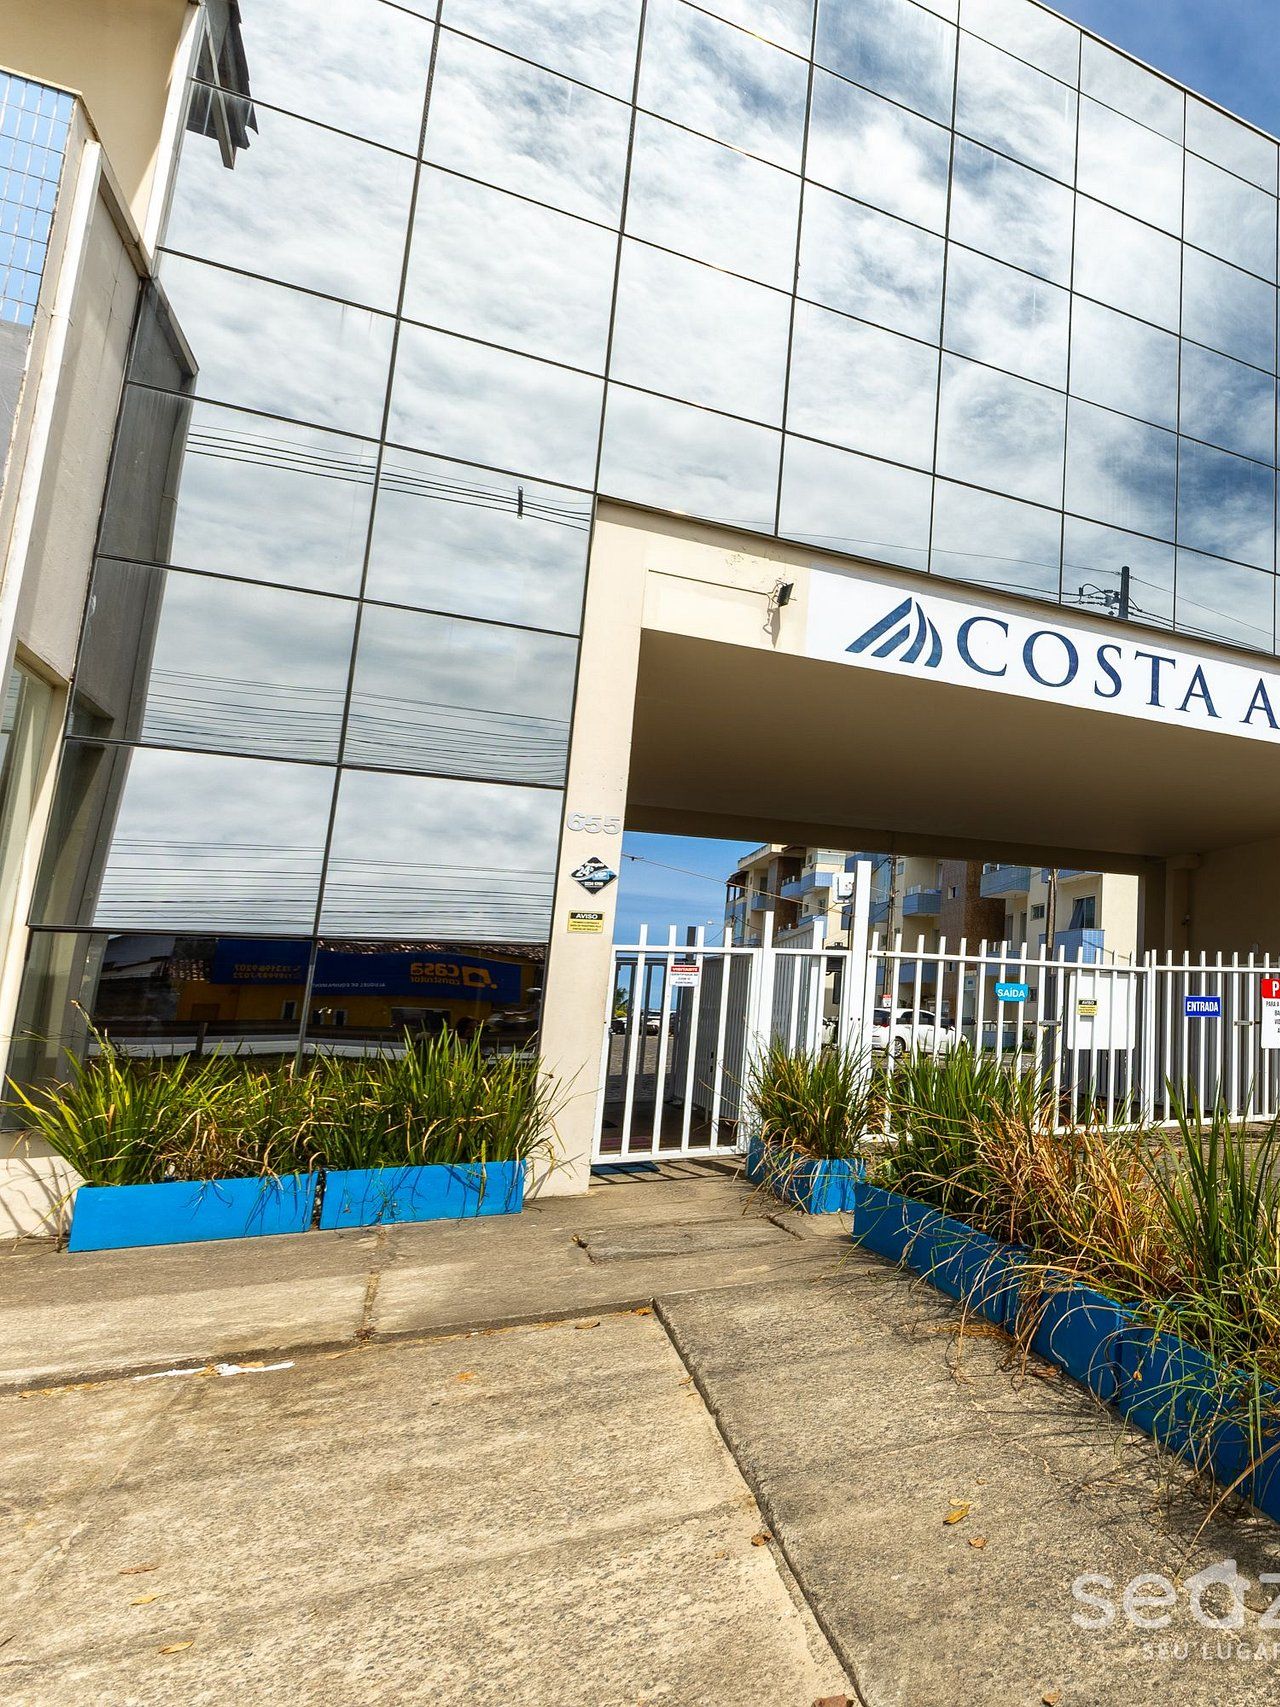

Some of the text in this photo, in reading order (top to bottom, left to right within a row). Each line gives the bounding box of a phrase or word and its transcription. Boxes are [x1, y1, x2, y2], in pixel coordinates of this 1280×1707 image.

[956, 616, 1222, 719] COSTA
[567, 812, 621, 834] 655
[997, 986, 1025, 998] SAÍDA
[1186, 1002, 1219, 1012] ENTRADA
